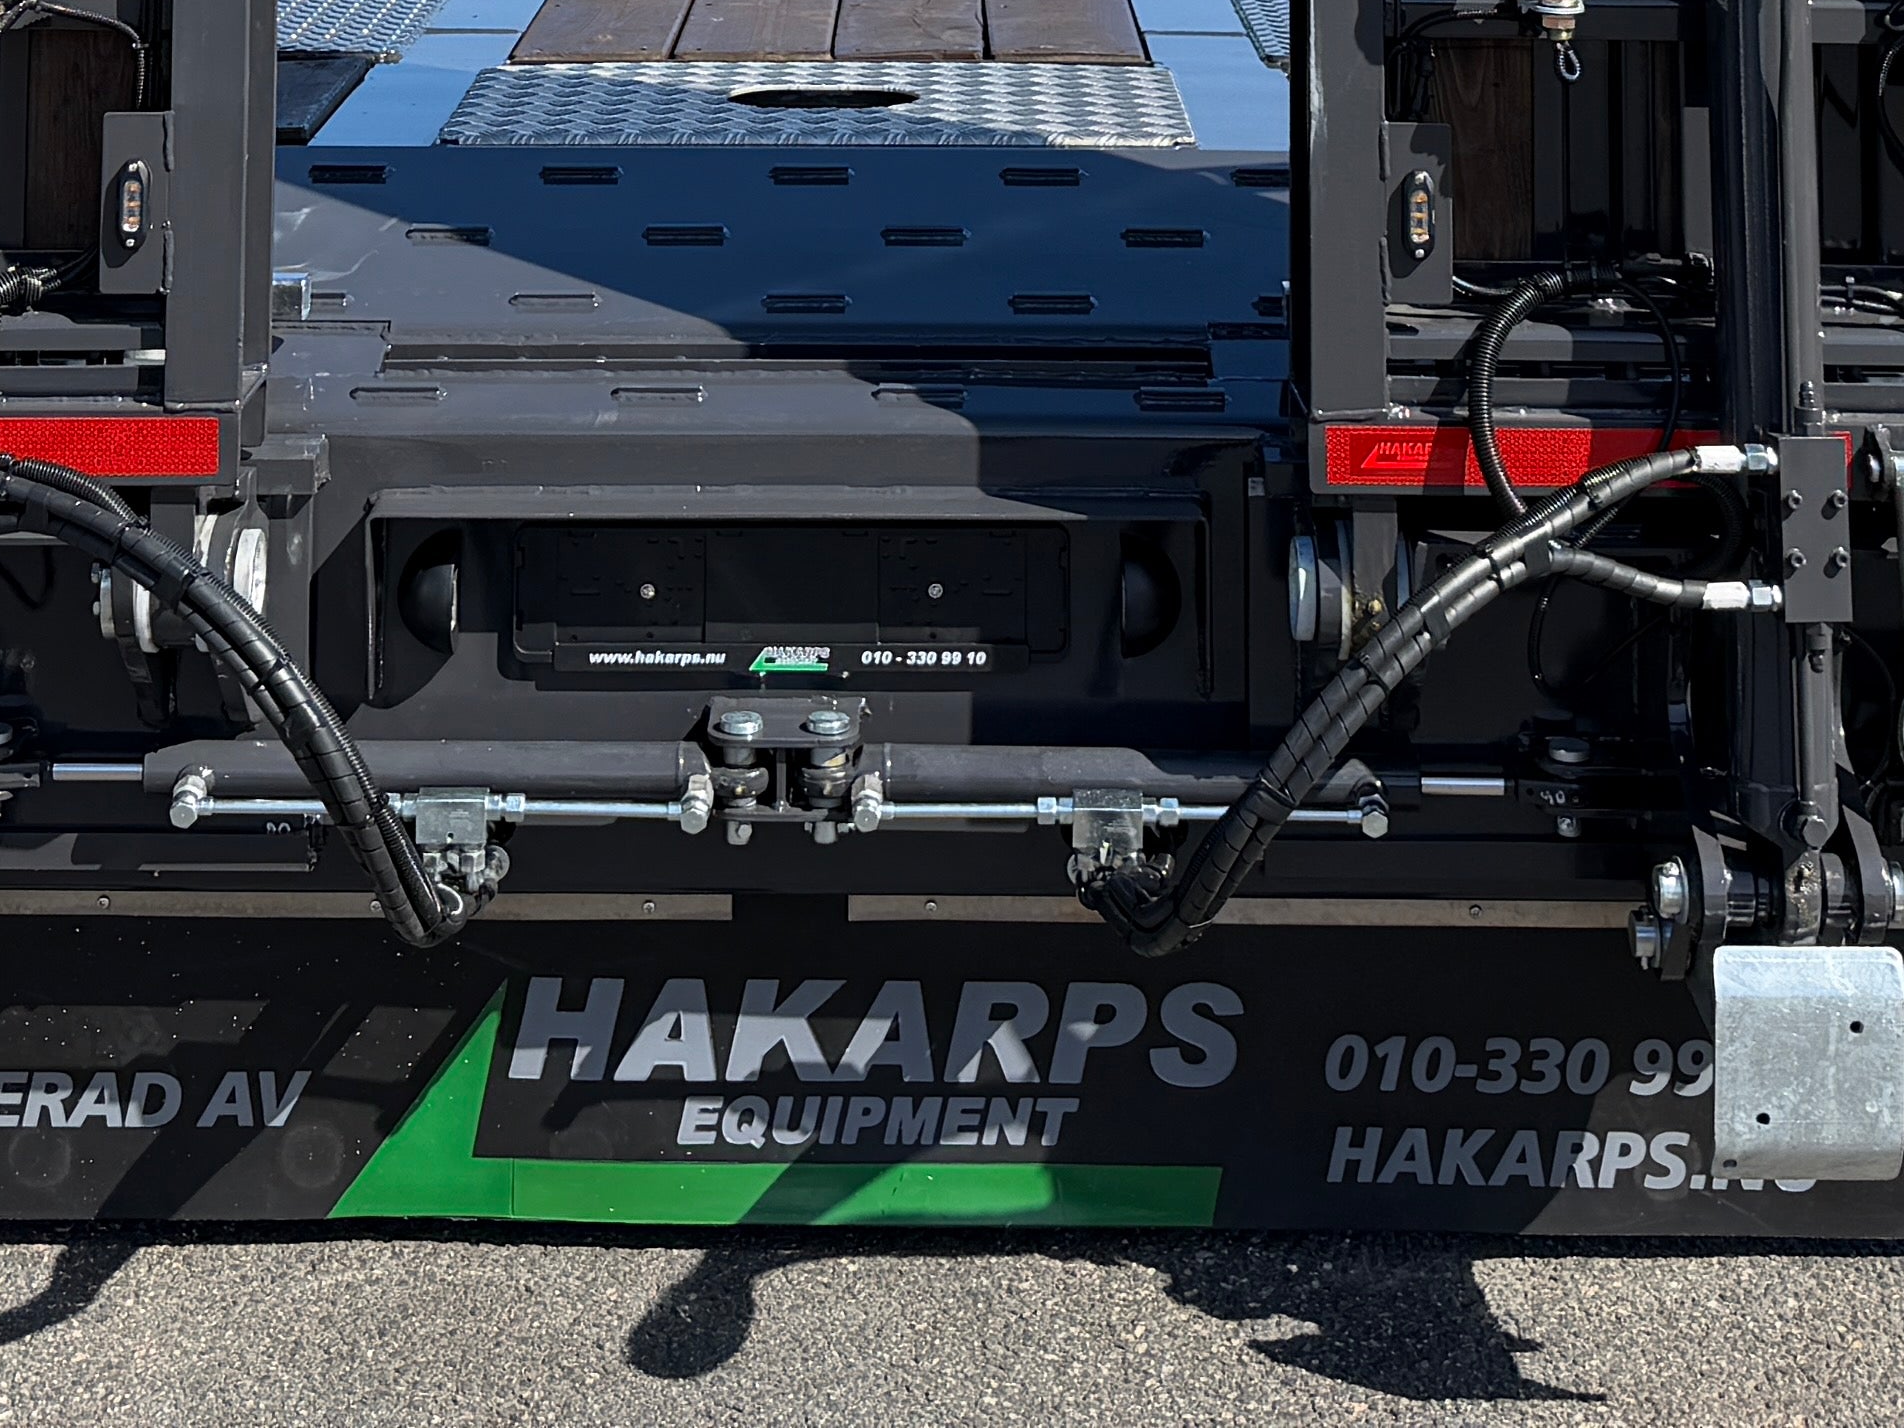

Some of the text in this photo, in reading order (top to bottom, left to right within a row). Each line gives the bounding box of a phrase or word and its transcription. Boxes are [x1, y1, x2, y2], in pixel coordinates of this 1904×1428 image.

[589, 650, 726, 667] www.hakarps.nu
[861, 650, 893, 664] 010
[906, 651, 937, 665] 330
[941, 651, 962, 665] 99
[966, 651, 987, 665] 10
[508, 977, 1243, 1087] HAKARPS
[1327, 1039, 1714, 1097] 010-330 99
[197, 1071, 312, 1128] AV
[677, 1096, 1080, 1149] EQUIPMENT
[1327, 1127, 1817, 1192] HAKARPS.
